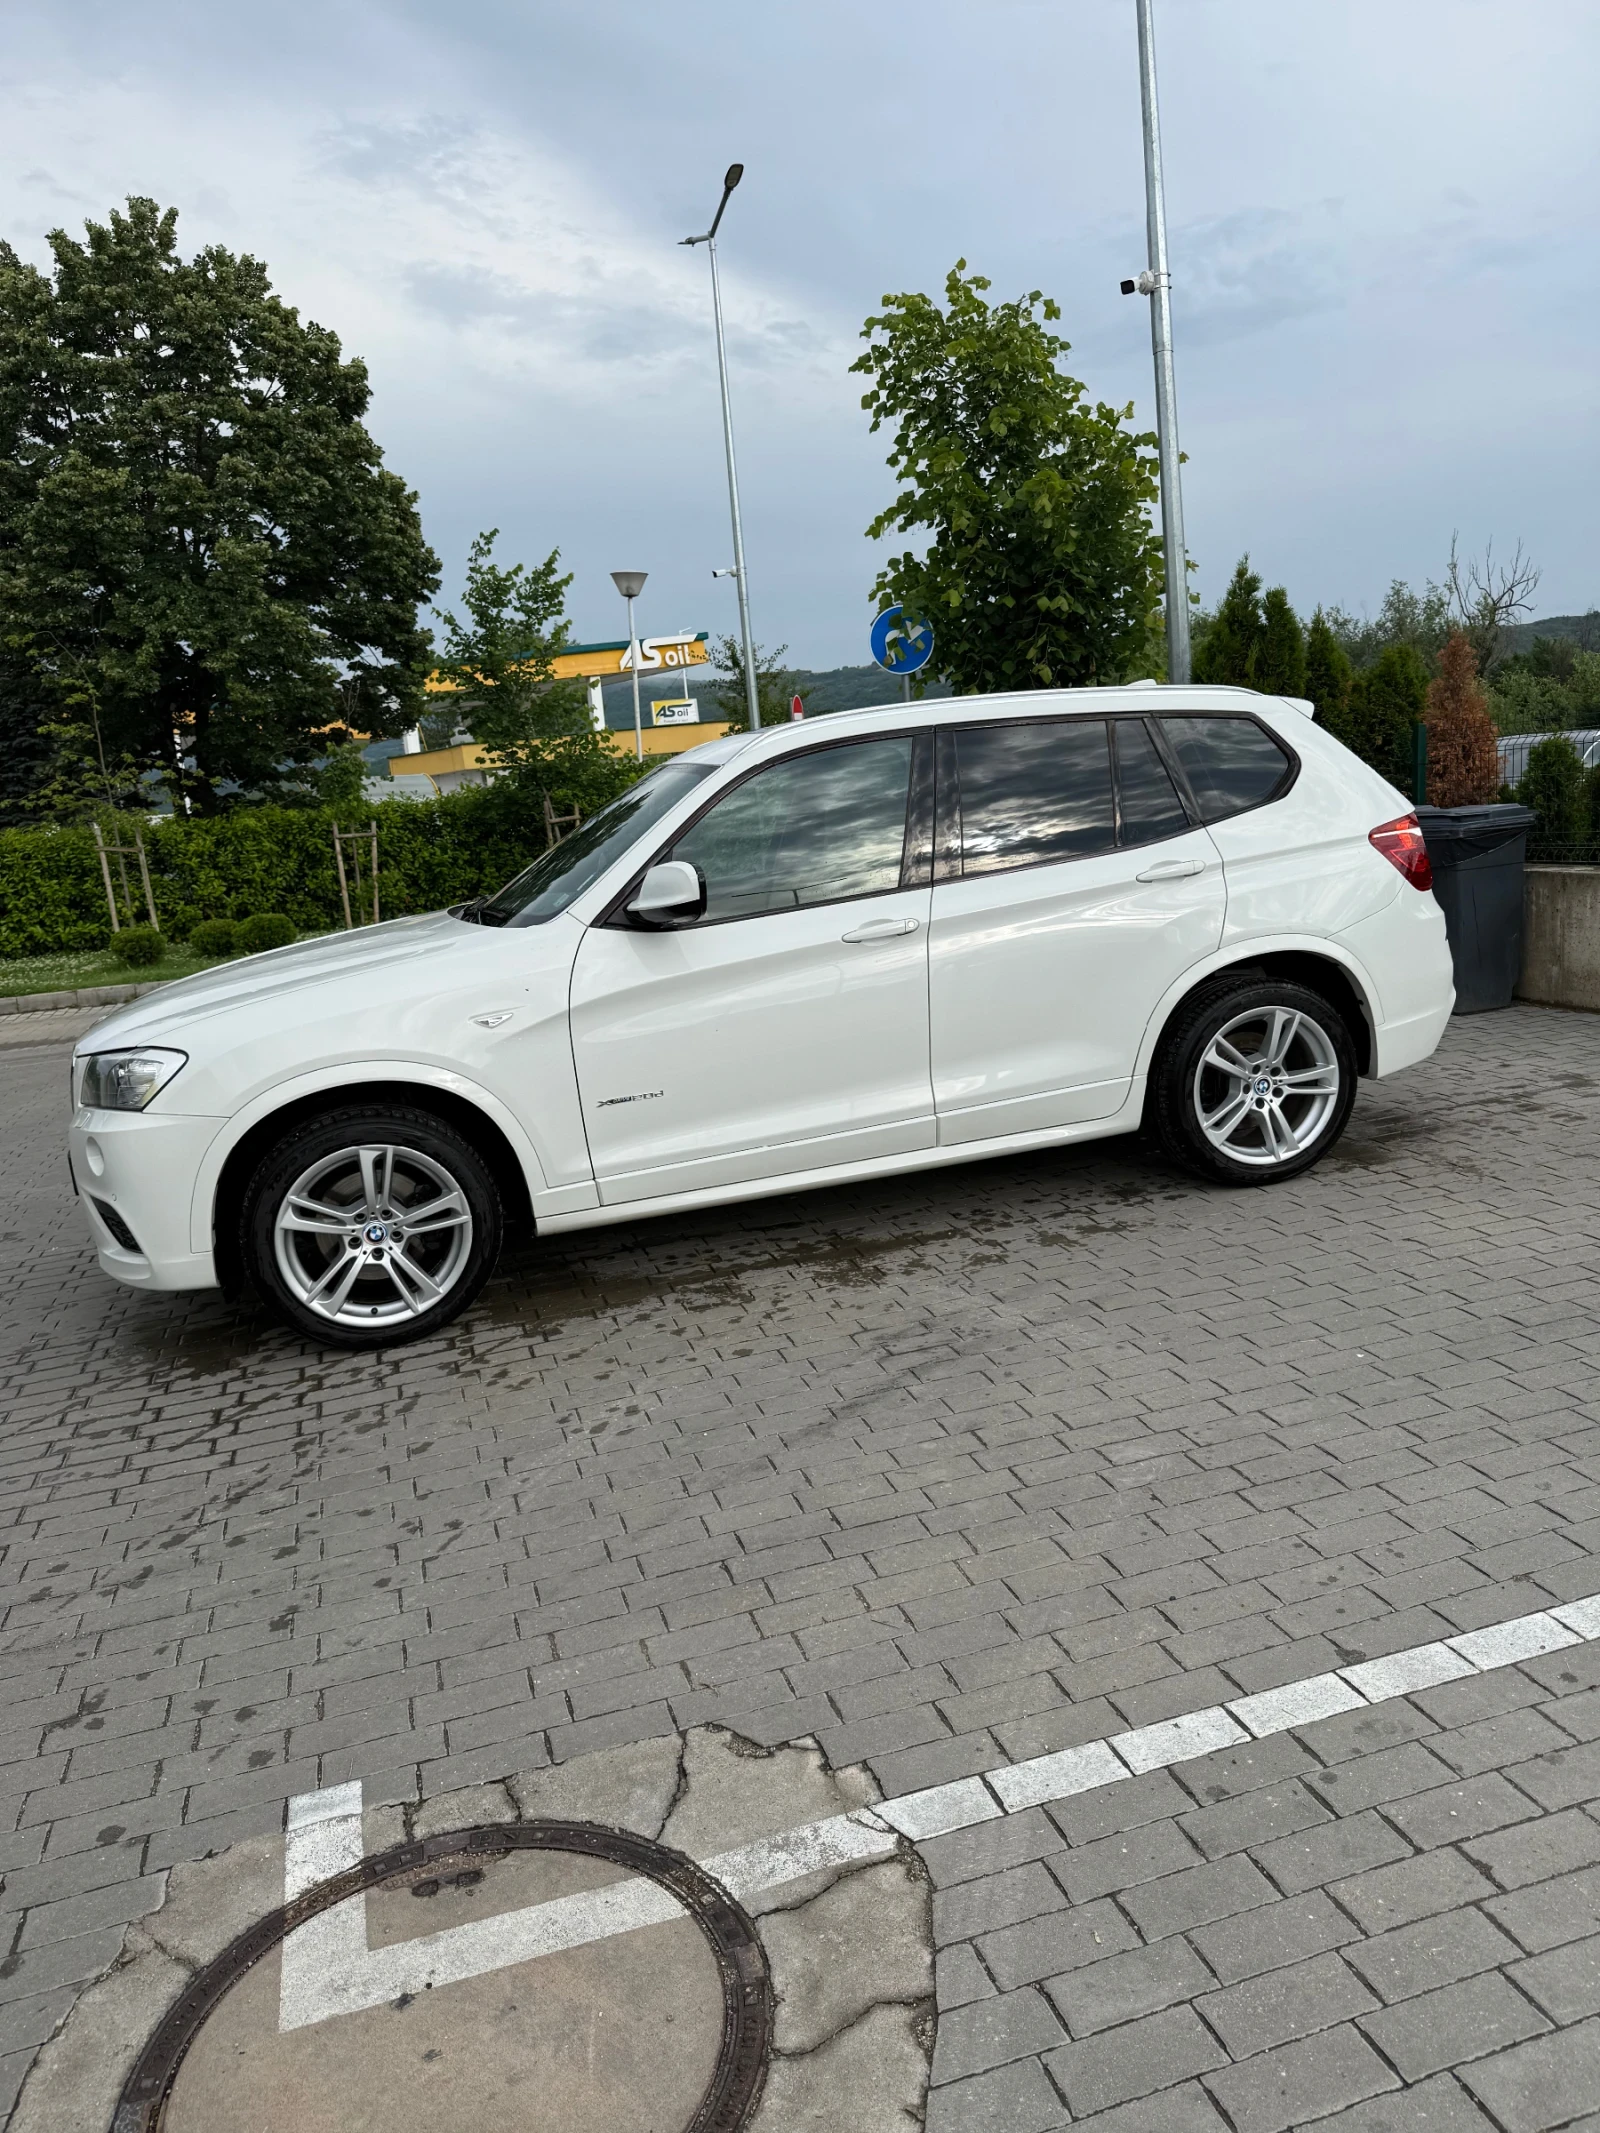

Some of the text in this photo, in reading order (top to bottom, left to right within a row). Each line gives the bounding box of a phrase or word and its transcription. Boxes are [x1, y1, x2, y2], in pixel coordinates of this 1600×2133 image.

[619, 633, 698, 672] AS oil
[656, 704, 693, 719] AS oil
